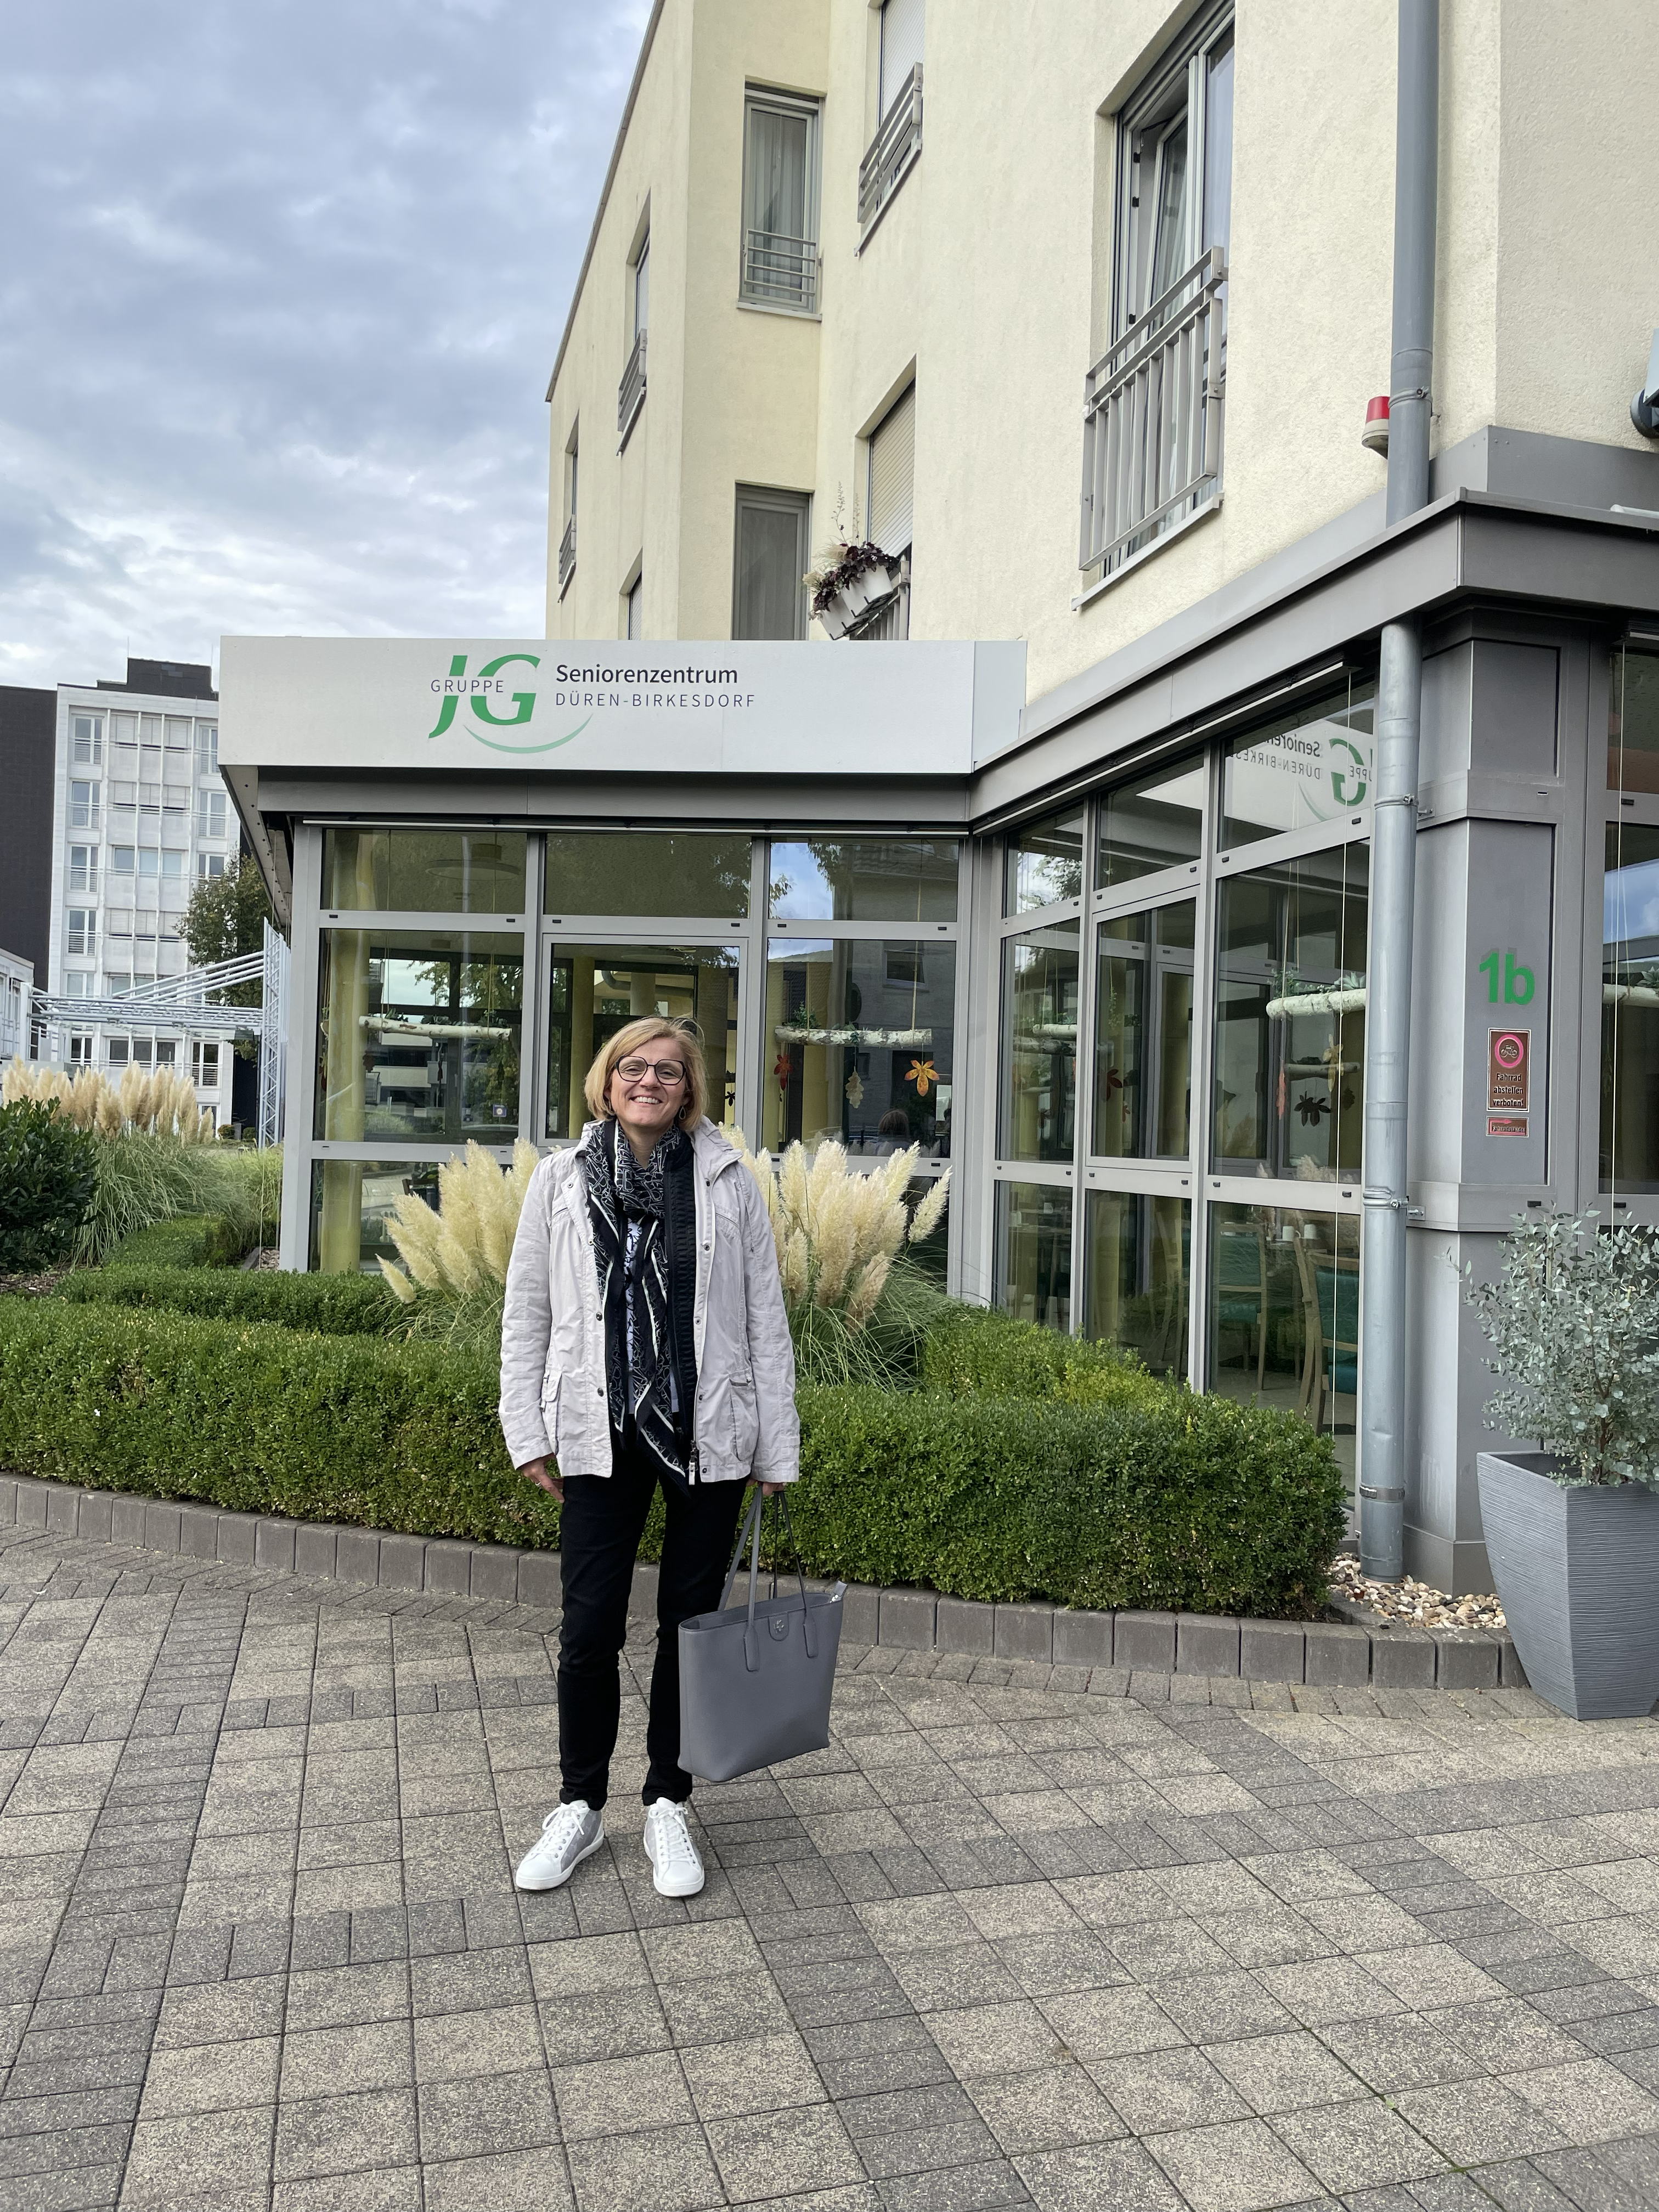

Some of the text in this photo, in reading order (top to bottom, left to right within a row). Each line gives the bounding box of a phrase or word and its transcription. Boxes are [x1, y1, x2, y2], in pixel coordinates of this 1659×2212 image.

[555, 664, 738, 684] Seniorenzentrum
[431, 679, 504, 693] GRUPPE
[555, 690, 755, 708] DÜREN-BIRKESDORF
[1479, 951, 1535, 1005] 1b
[1496, 1073, 1522, 1081] Fahrrad
[1493, 1086, 1523, 1094] abstellen
[1493, 1099, 1524, 1107] verboten!
